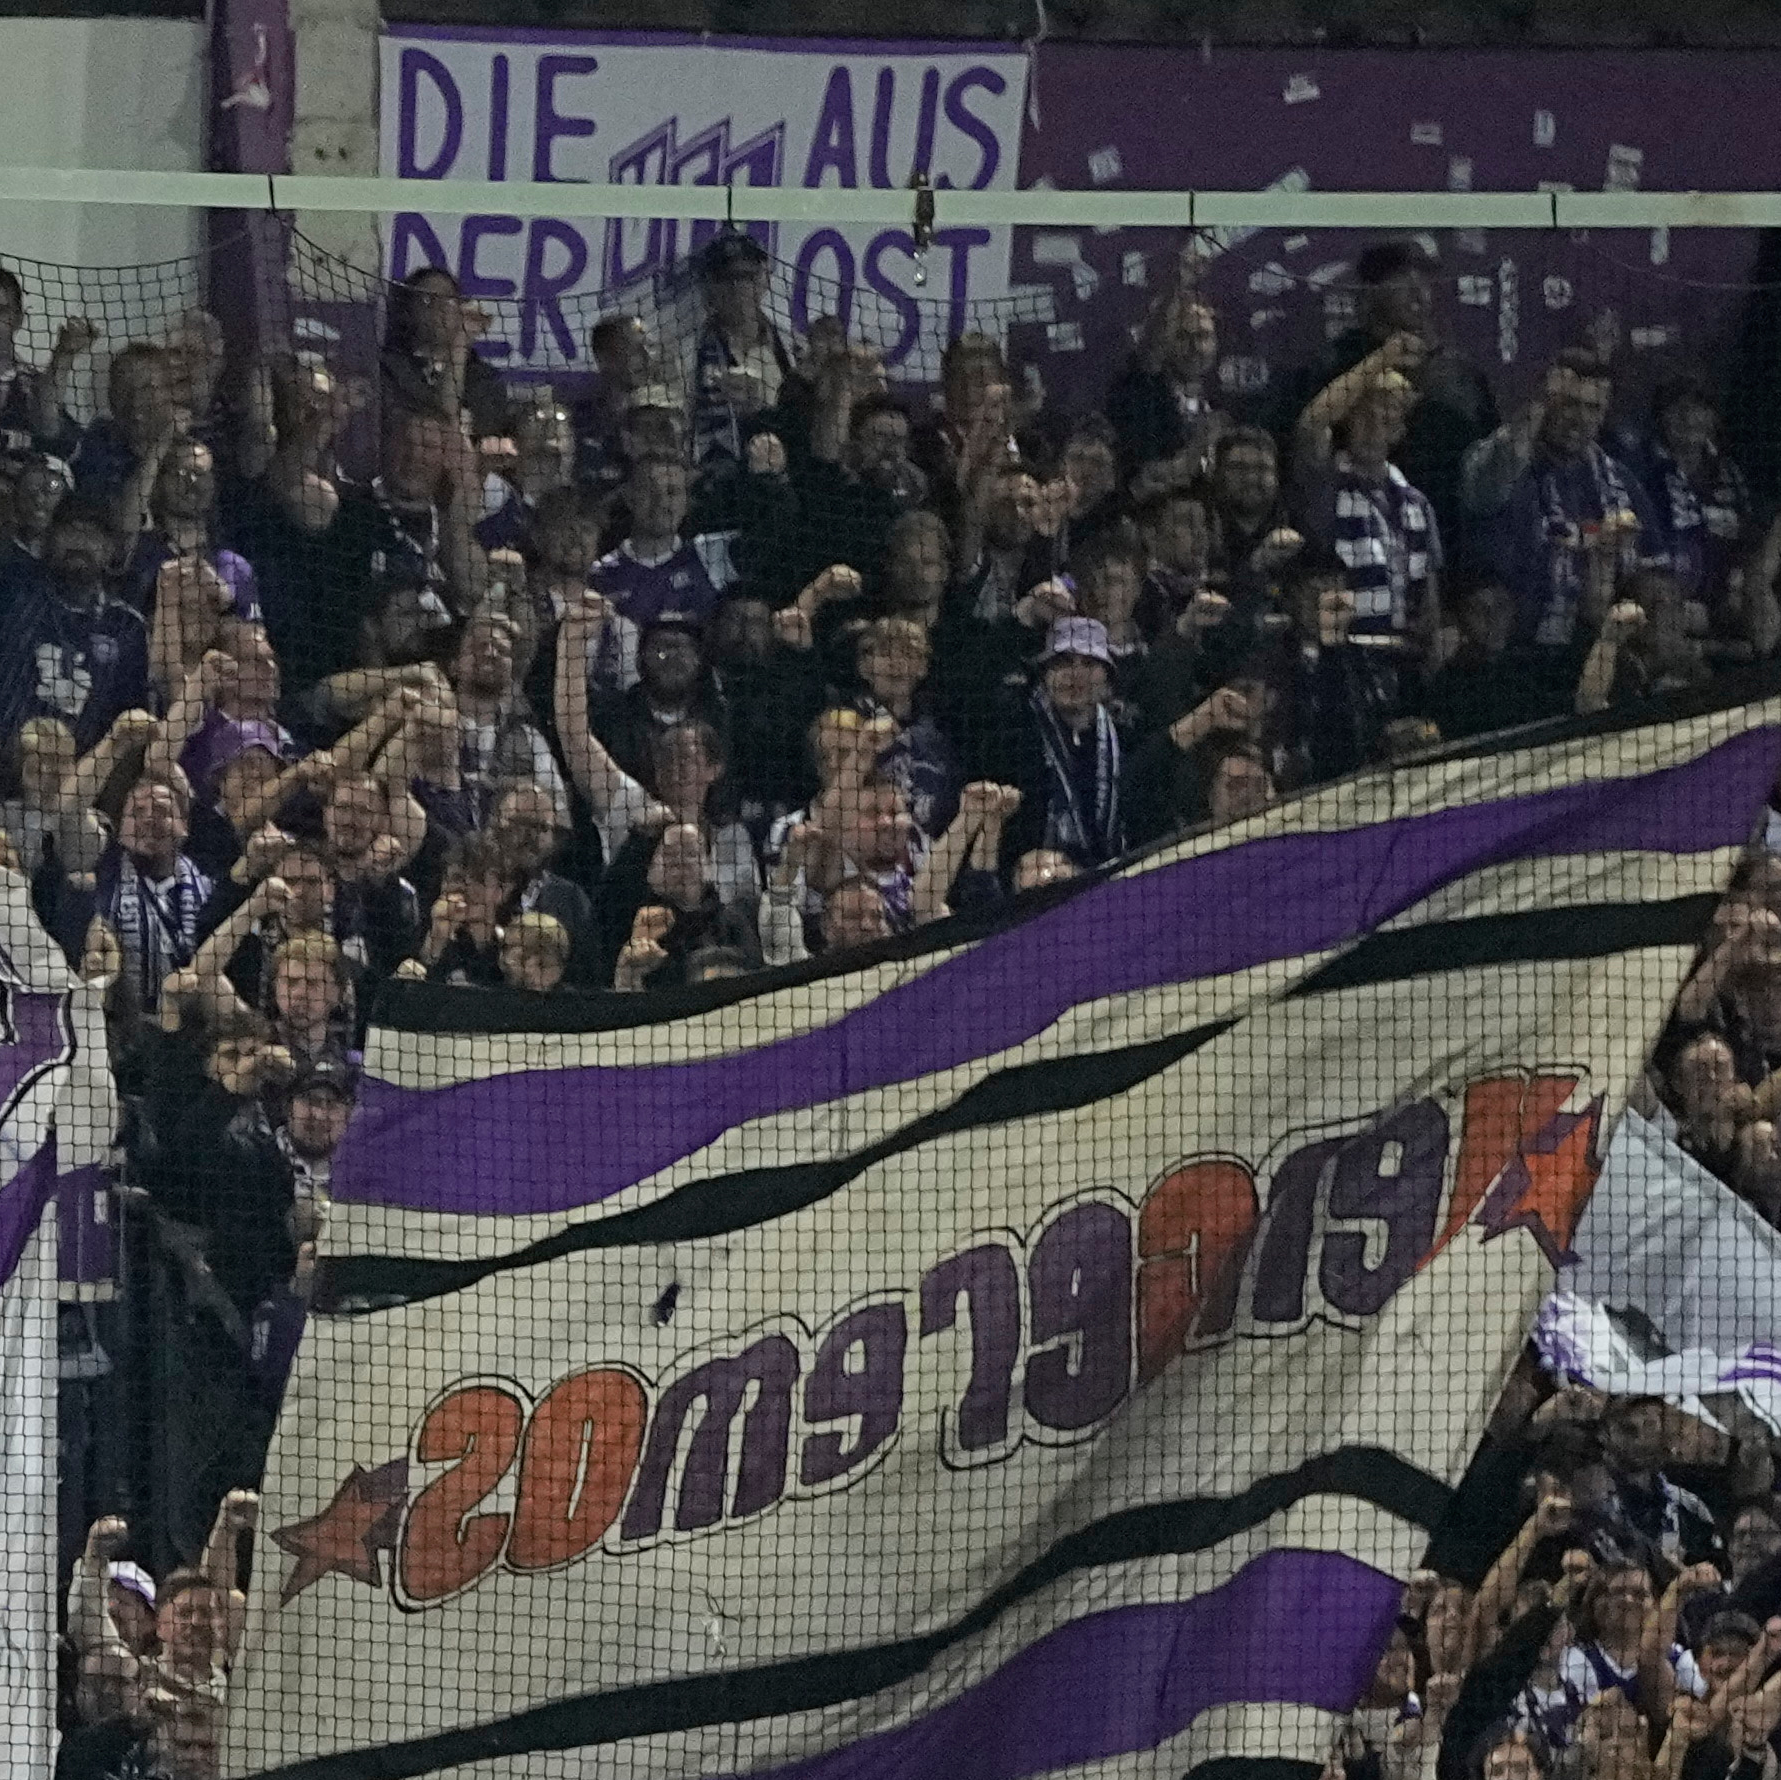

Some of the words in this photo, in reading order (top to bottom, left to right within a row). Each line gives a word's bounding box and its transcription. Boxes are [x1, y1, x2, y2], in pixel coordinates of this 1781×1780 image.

[396, 47, 599, 183] DIE
[802, 65, 1008, 191] AUS
[790, 226, 992, 366] OST
